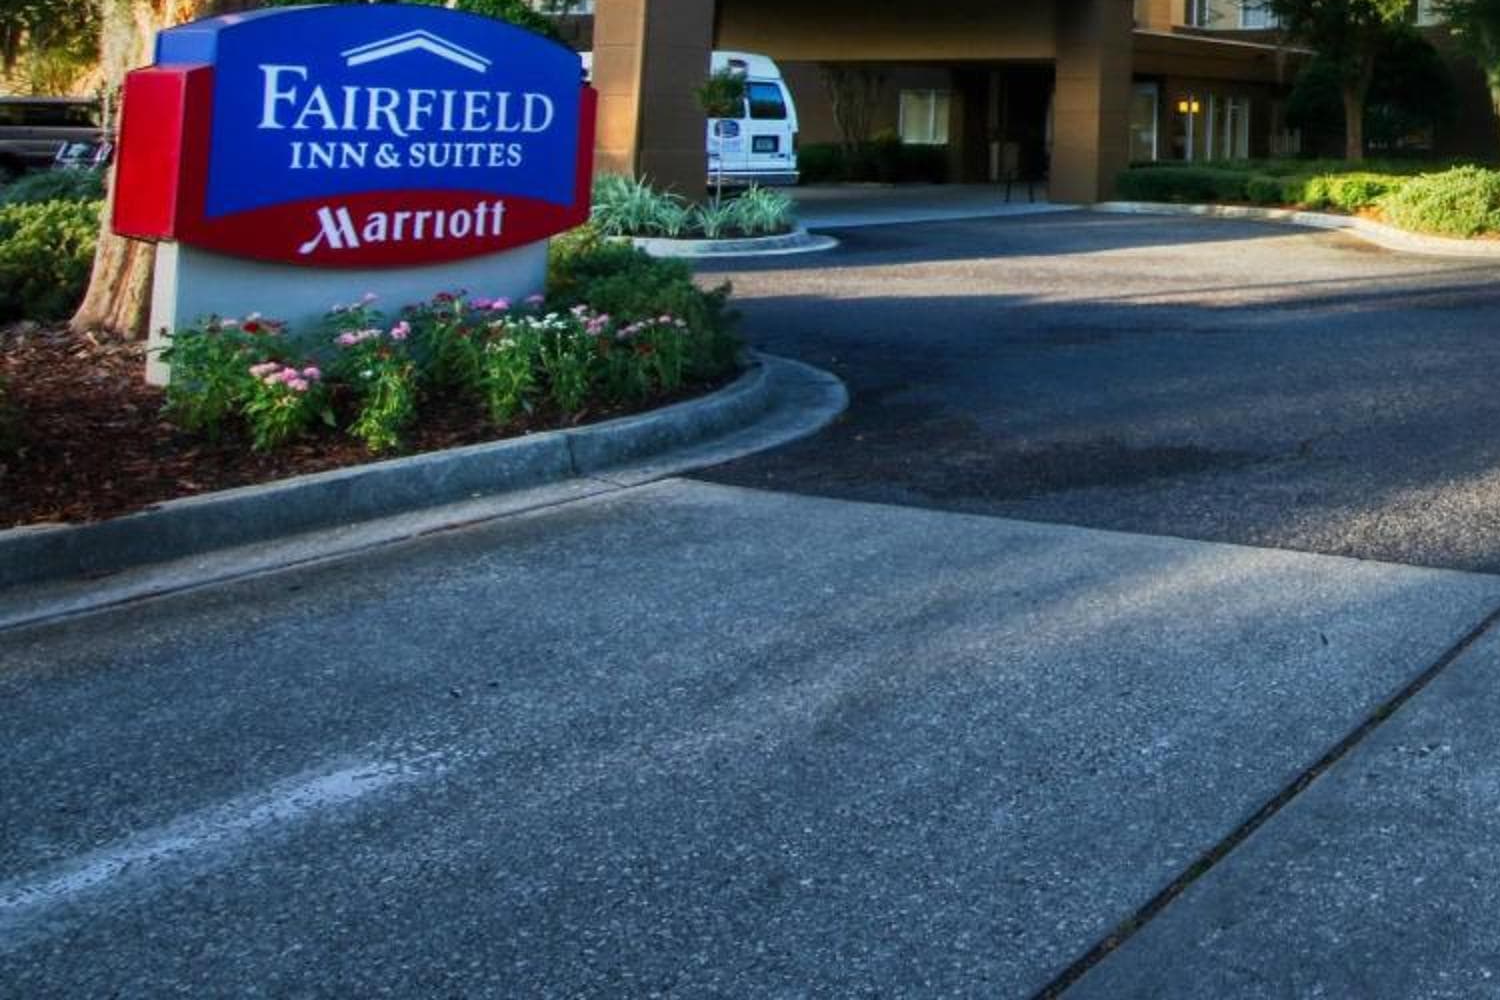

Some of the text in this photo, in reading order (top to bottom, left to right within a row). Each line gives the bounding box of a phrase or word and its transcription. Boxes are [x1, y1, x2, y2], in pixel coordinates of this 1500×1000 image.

[257, 63, 554, 137] FAIRFIELD
[290, 142, 523, 169] INN & SUITES
[298, 200, 506, 255] Marriott
